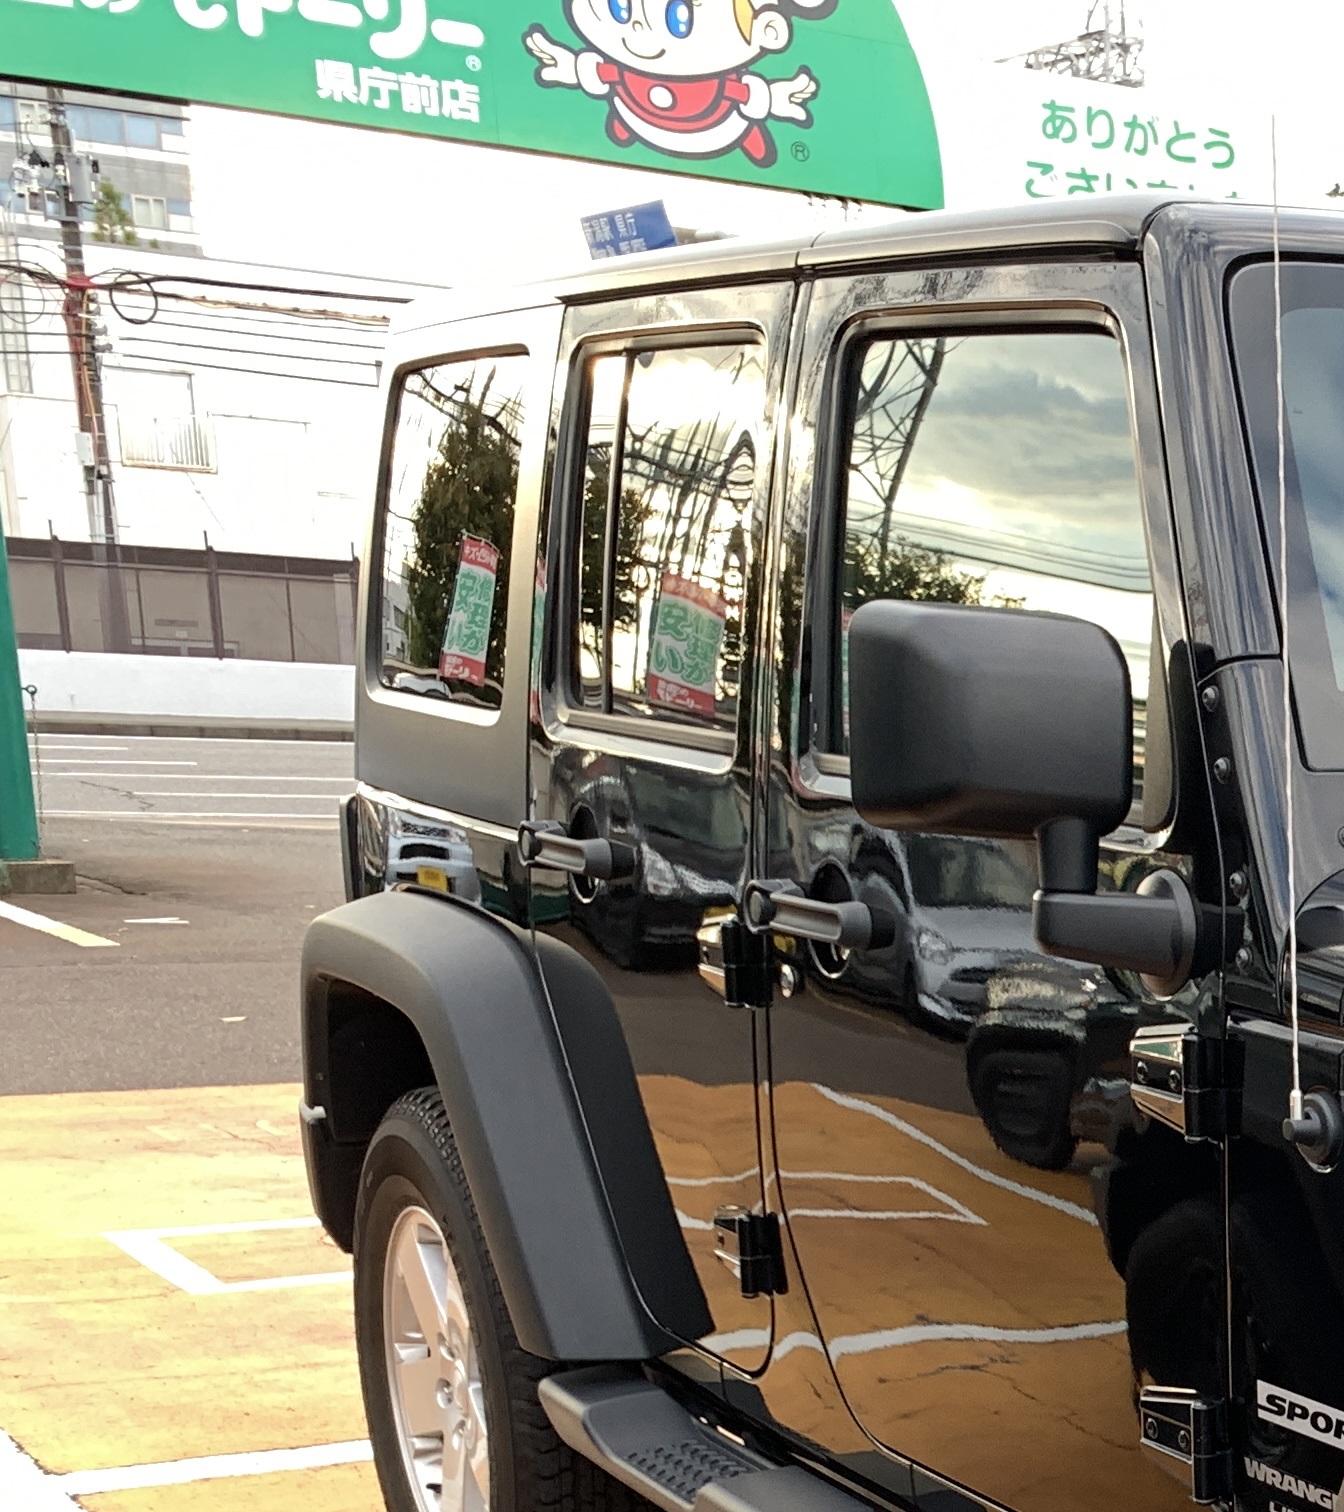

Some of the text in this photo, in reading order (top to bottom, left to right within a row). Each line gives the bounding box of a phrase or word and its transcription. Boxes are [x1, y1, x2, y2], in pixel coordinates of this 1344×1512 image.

[315, 59, 480, 123] 県庁前店
[1041, 99, 1235, 169] ありがとう
